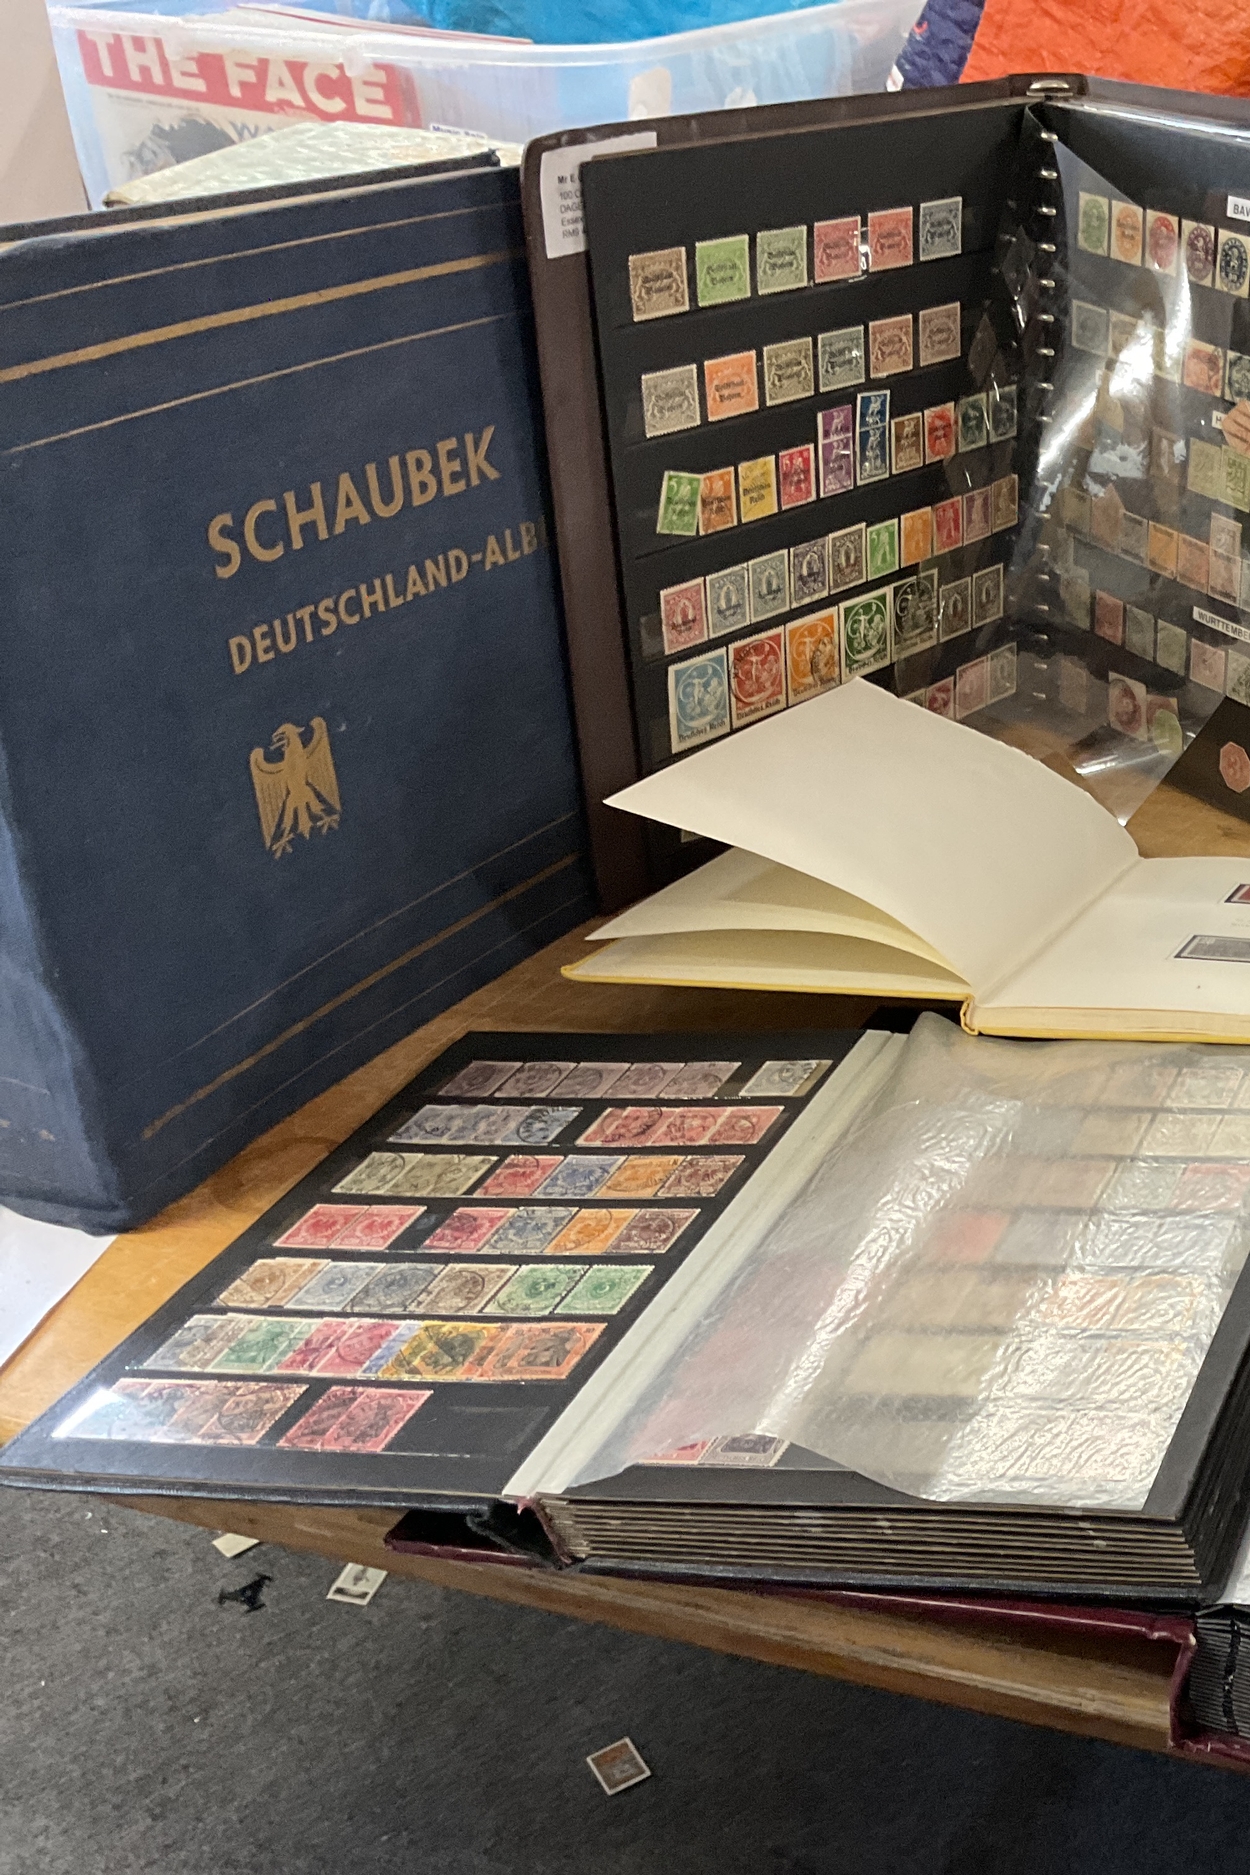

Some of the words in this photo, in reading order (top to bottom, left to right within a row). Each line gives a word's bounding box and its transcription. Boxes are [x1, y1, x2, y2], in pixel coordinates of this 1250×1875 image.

[85, 31, 207, 92] THE
[222, 51, 393, 119] FACE
[207, 425, 501, 579] SCHAUBEK
[228, 516, 543, 675] DEUTSCHLAND-ALB
